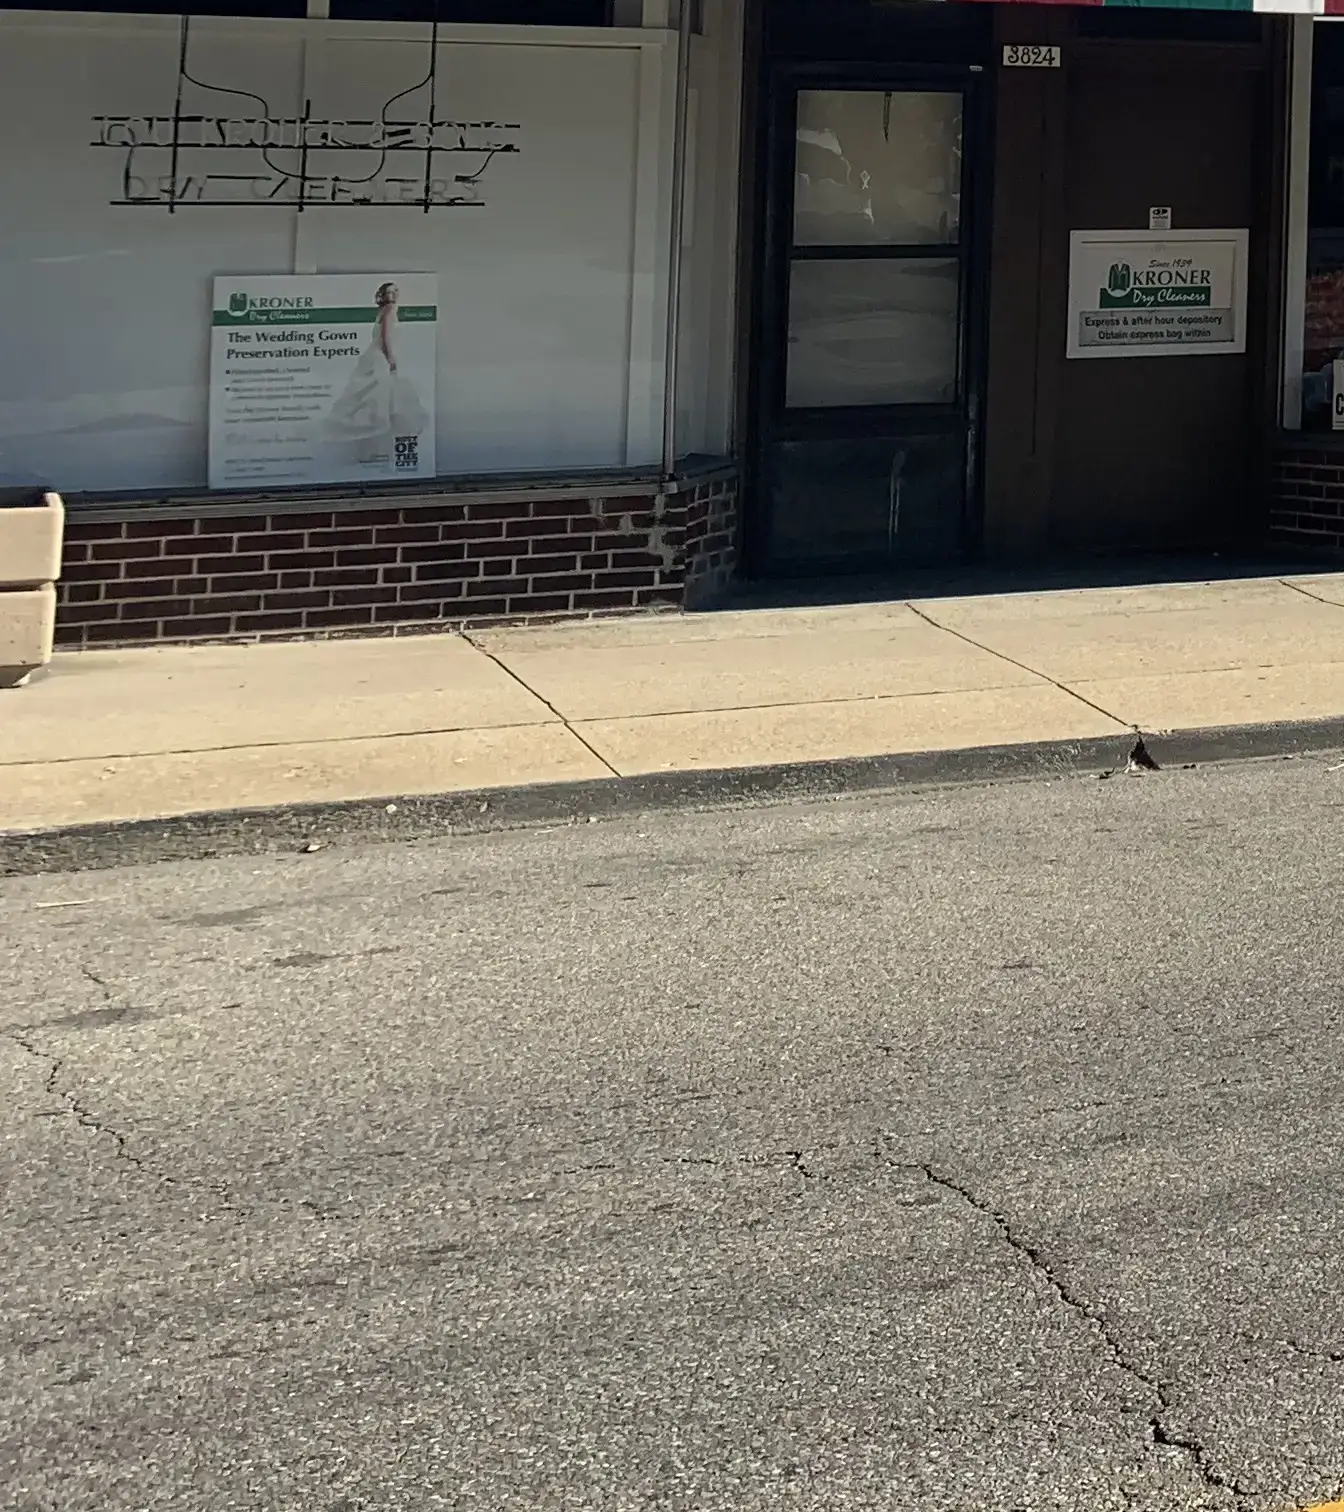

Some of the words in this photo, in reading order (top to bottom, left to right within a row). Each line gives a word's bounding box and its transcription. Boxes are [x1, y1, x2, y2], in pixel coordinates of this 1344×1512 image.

[1007, 46, 1056, 65] 3824
[1148, 259, 1170, 269] Since
[1132, 269, 1211, 287] KRONER
[249, 296, 314, 309] KRONER
[1132, 289, 1155, 307] Dry
[1157, 288, 1206, 303] Cleaners
[1084, 317, 1120, 327] Express
[1122, 316, 1129, 325] &
[1131, 316, 1152, 326] after
[1154, 315, 1175, 325] hour
[1176, 315, 1223, 325] depository
[227, 332, 252, 344] The
[255, 330, 315, 344] Wedding
[318, 329, 358, 341] Gown
[226, 347, 309, 360] Preservation
[312, 345, 361, 360] Experts
[394, 443, 418, 455] OF
